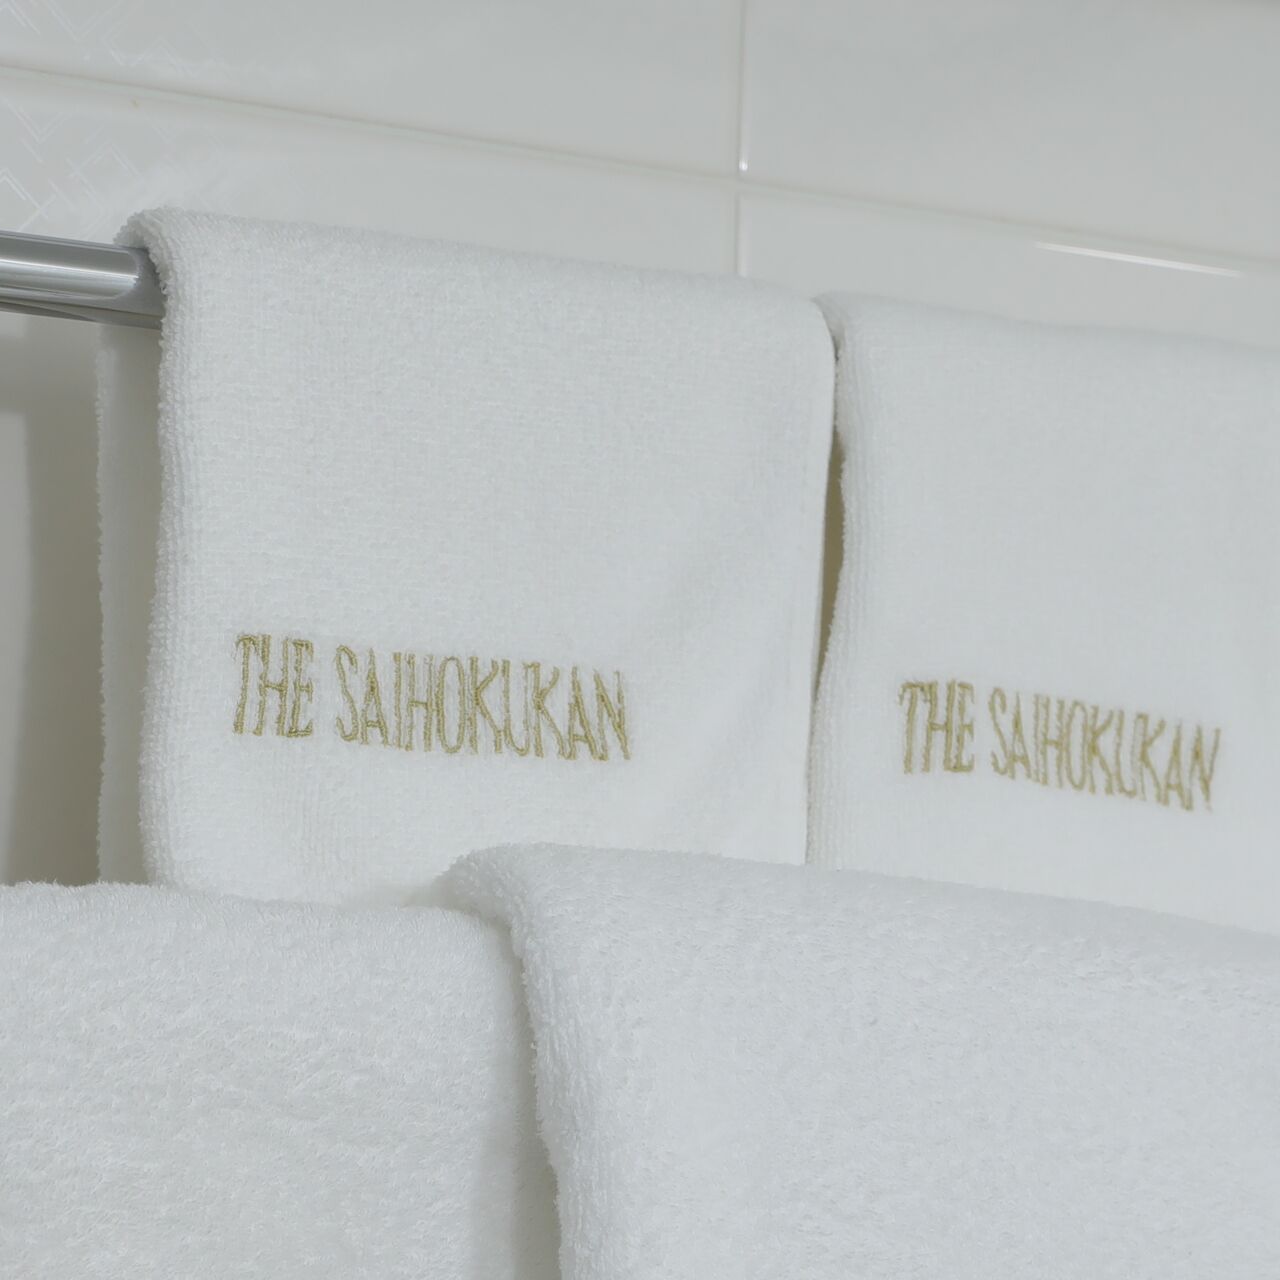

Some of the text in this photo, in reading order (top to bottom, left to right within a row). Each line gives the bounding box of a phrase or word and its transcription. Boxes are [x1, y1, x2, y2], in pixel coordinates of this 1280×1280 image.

[232, 633, 631, 761] THE SAIHOKUKAN
[899, 679, 1222, 811] THE SAIHOKUKAN
